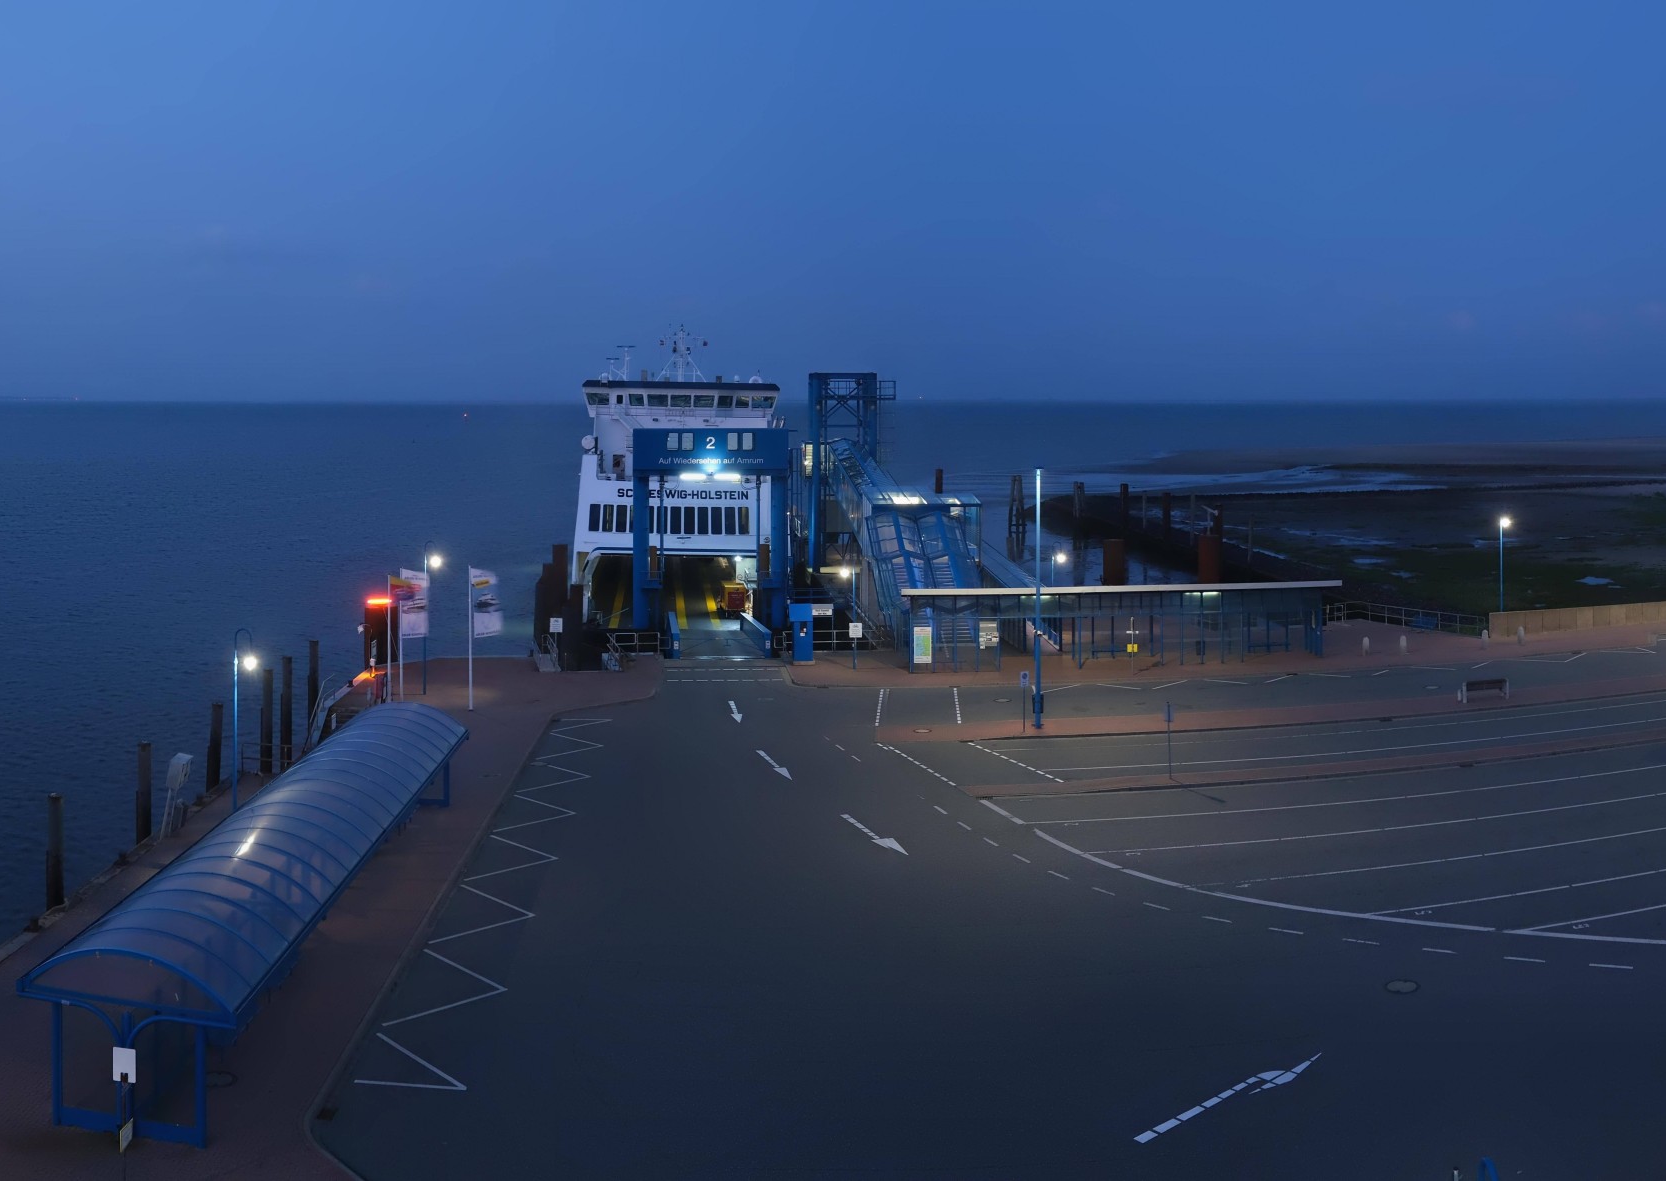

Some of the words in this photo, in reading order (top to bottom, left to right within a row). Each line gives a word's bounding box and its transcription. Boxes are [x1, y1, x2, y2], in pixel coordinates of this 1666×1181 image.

[706, 436, 716, 449] 2
[658, 457, 671, 465] Auf
[673, 457, 721, 465] Wiedersehen
[723, 457, 735, 465] auf
[737, 457, 764, 465] Amrum
[617, 488, 749, 500] SCESWIG-HOLSTEIN
